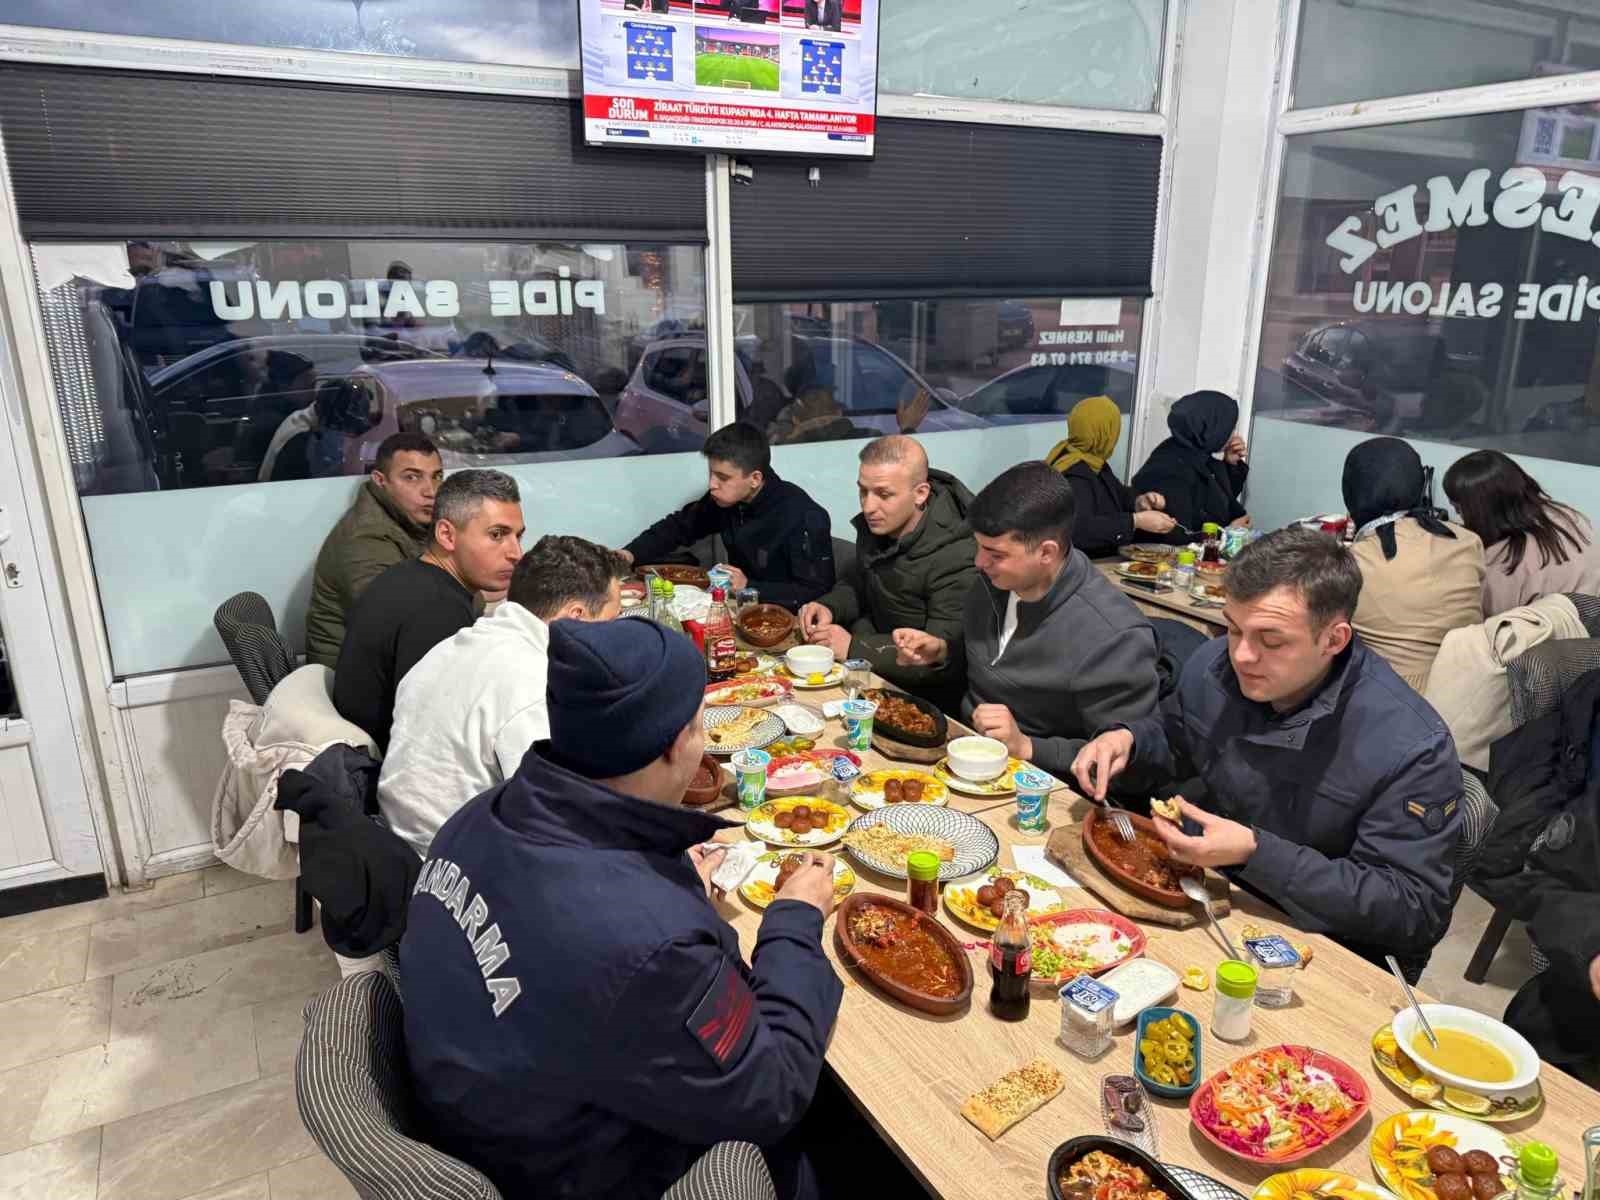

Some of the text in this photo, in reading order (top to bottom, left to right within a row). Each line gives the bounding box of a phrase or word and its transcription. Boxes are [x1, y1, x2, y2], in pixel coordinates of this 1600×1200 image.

[607, 108, 649, 120] DURUM
[654, 100, 682, 112] ZİRAAT
[684, 102, 719, 115] TÜRKİYE
[776, 110, 798, 121] HAFTA
[412, 858, 522, 1018] ANDARMA
